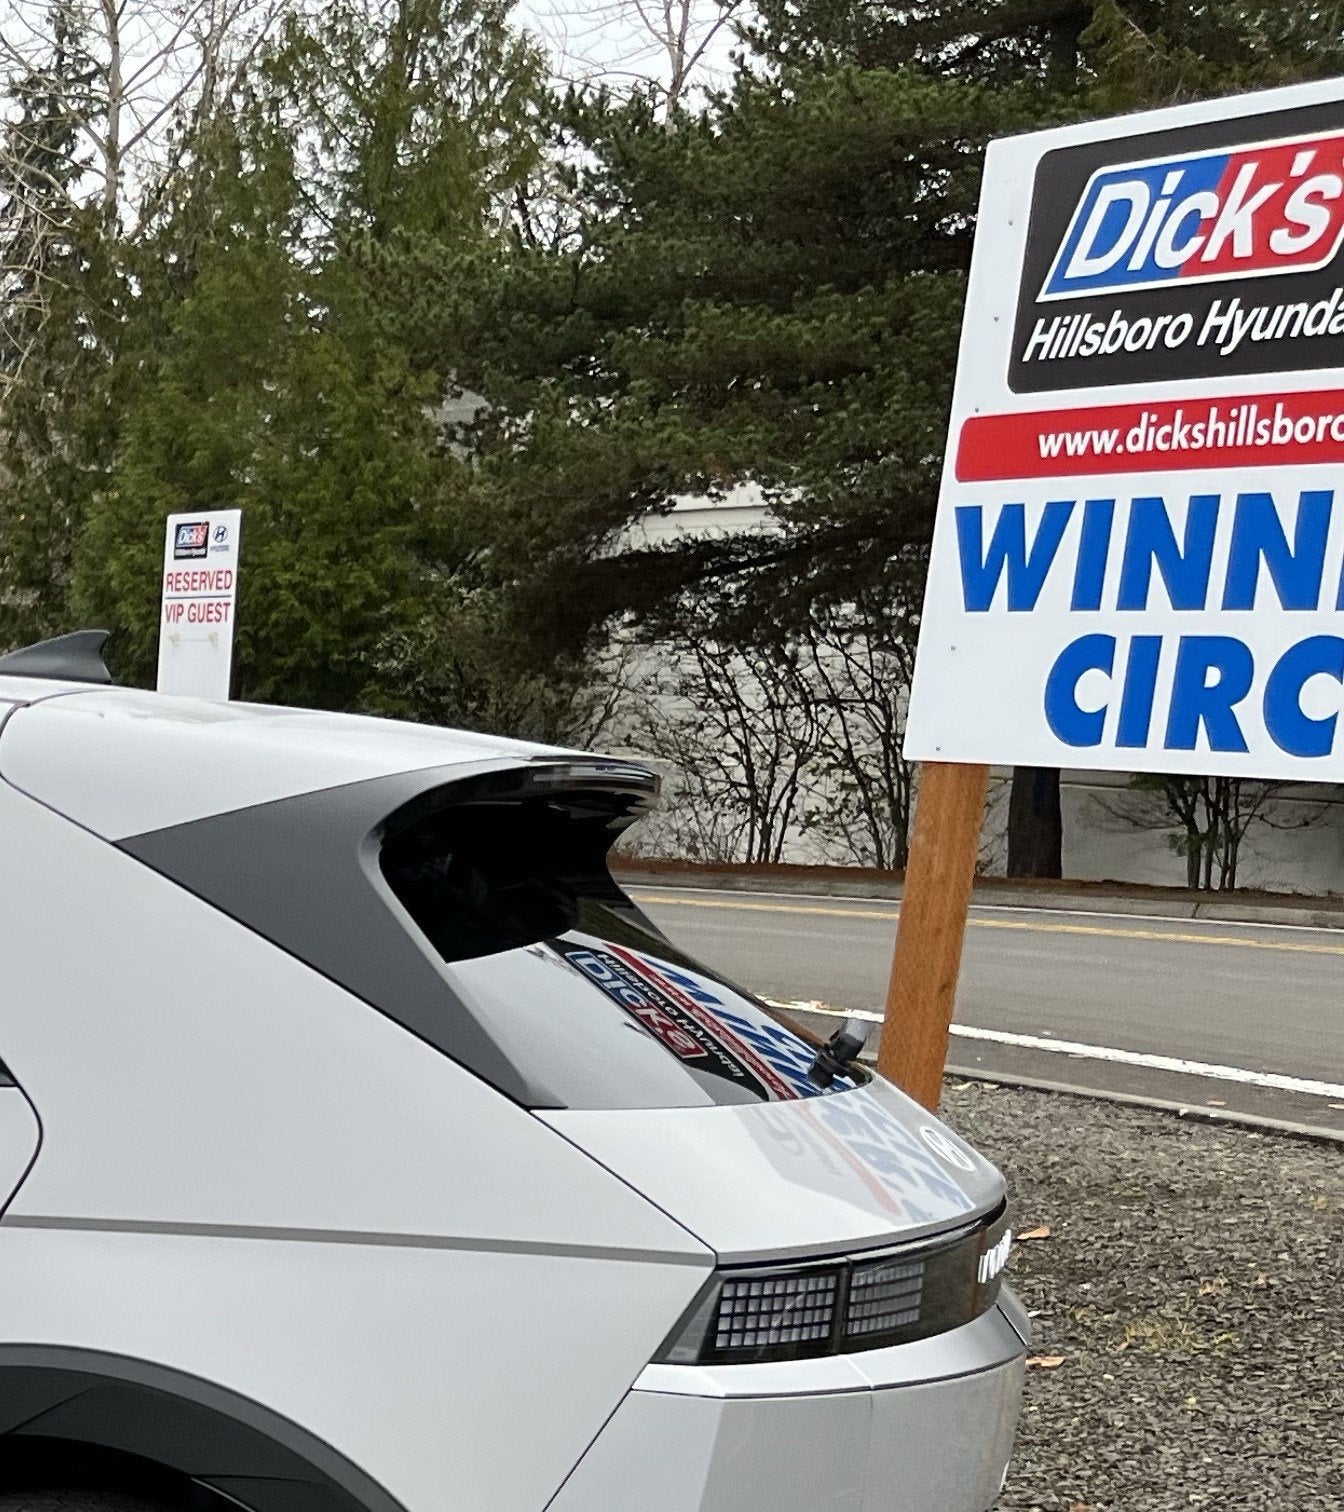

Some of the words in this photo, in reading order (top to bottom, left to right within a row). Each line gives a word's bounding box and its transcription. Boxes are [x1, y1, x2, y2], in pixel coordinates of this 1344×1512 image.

[1063, 150, 1342, 279] Dick's
[1022, 305, 1194, 364] Hillsboro
[166, 569, 233, 592] RESERVED
[955, 490, 1344, 613] WINN
[165, 604, 184, 624] VIP
[187, 602, 231, 623] GUEST
[1044, 633, 1344, 759] CIRC
